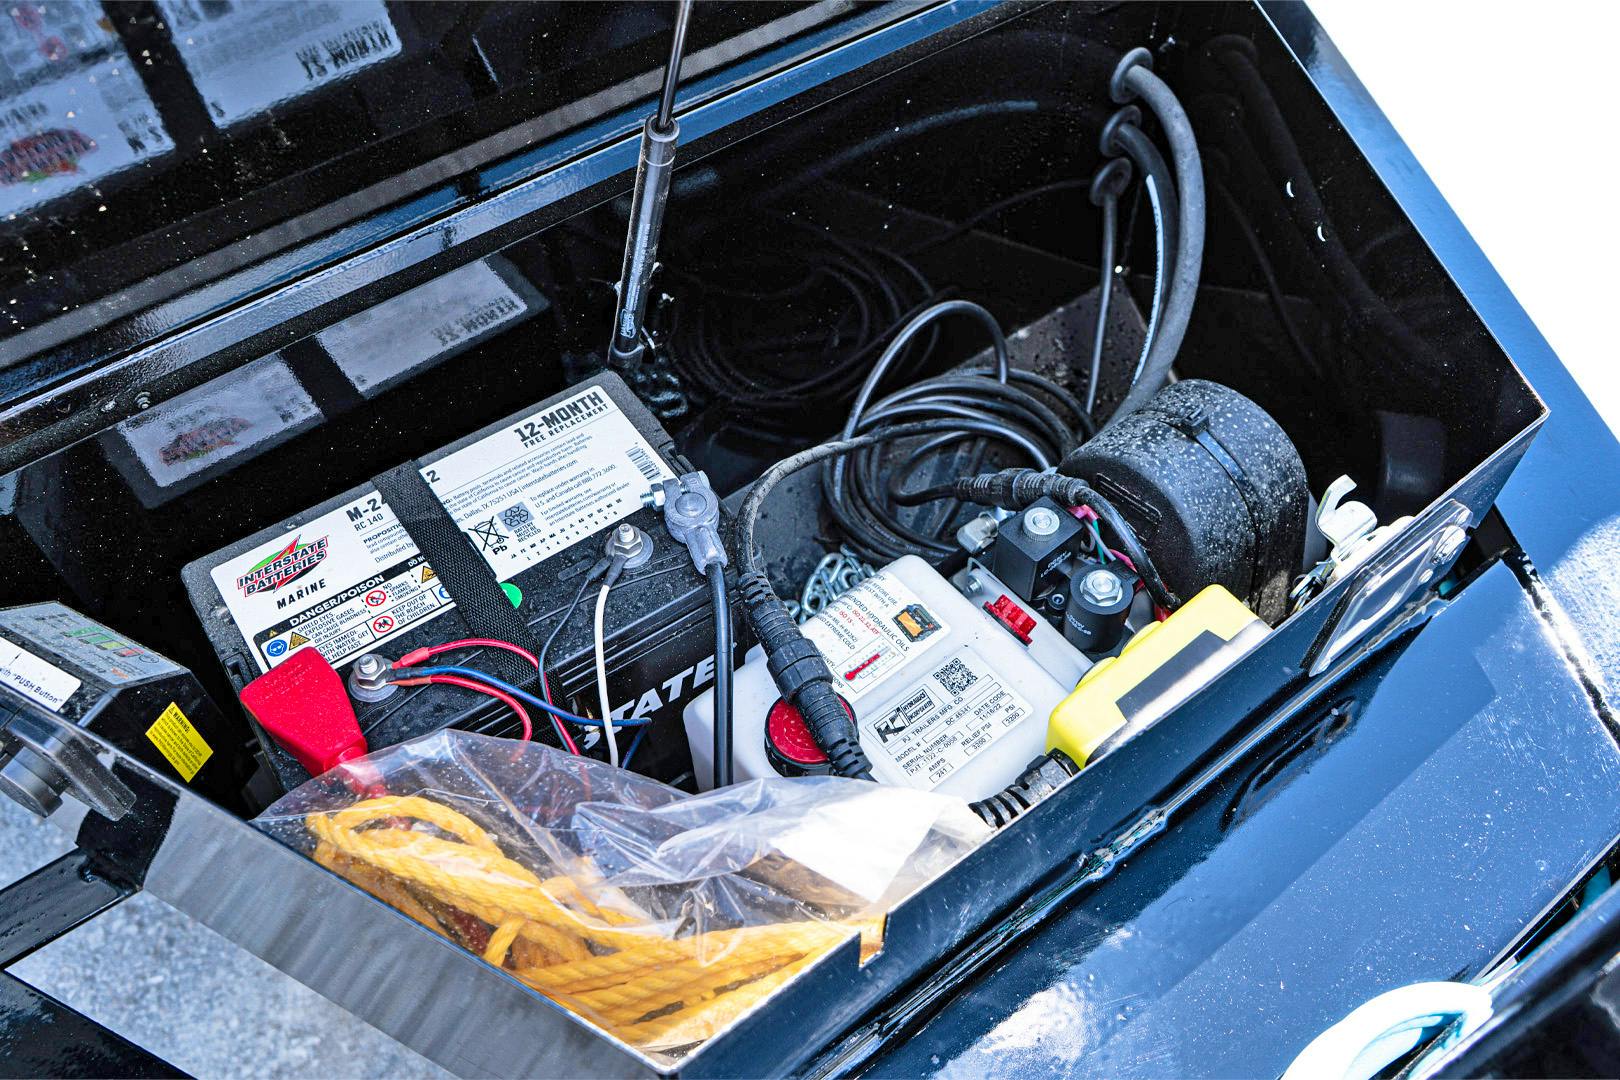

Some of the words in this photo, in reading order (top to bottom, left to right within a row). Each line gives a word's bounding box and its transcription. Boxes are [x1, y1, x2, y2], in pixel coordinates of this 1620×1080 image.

[513, 390, 604, 442] 12-MONTH
[523, 433, 546, 448] FREE
[547, 403, 609, 436] REPLACEMENT
[506, 487, 519, 497] USA
[353, 520, 367, 531] RC
[366, 513, 384, 525] 140
[517, 528, 542, 543] RECYCLED
[373, 543, 407, 563] Distributed
[404, 540, 416, 548] by
[491, 543, 508, 555] Pb
[236, 539, 327, 586] INTERSTATE
[407, 558, 418, 566] DO
[244, 550, 326, 594] BATTERIES
[274, 578, 328, 609] MARINE
[381, 582, 393, 590] NO
[389, 580, 408, 592] SPARKS
[394, 586, 418, 600] SMOKING
[288, 574, 384, 626] DANGER/POISON
[390, 604, 406, 615] KEEP
[405, 598, 419, 607] OUT
[417, 593, 427, 601] OF
[394, 611, 406, 619] THE
[405, 601, 426, 613] REACH
[297, 618, 318, 633] SHIELD
[303, 617, 335, 636] EXPLOSIVE
[334, 607, 355, 619] GASES
[310, 631, 323, 639] CAN
[356, 629, 370, 638] GET
[865, 610, 897, 640] HYDRAULIC
[894, 638, 910, 652] OILS
[317, 642, 333, 652] EYES
[330, 648, 348, 658] HELP
[973, 702, 990, 716] DATE
[987, 689, 1006, 704] CODE
[1003, 703, 1016, 713] PSI
[902, 735, 911, 743] PJ
[911, 713, 940, 736] TRAILERS
[960, 729, 982, 747] RELIEF
[980, 721, 992, 732] PSI
[894, 744, 917, 762] MODEL
[945, 716, 955, 725] DC
[901, 752, 924, 770] SERIAL
[922, 733, 948, 754] NUMBER
[927, 756, 946, 772] AMPS
[935, 767, 948, 778] 241
